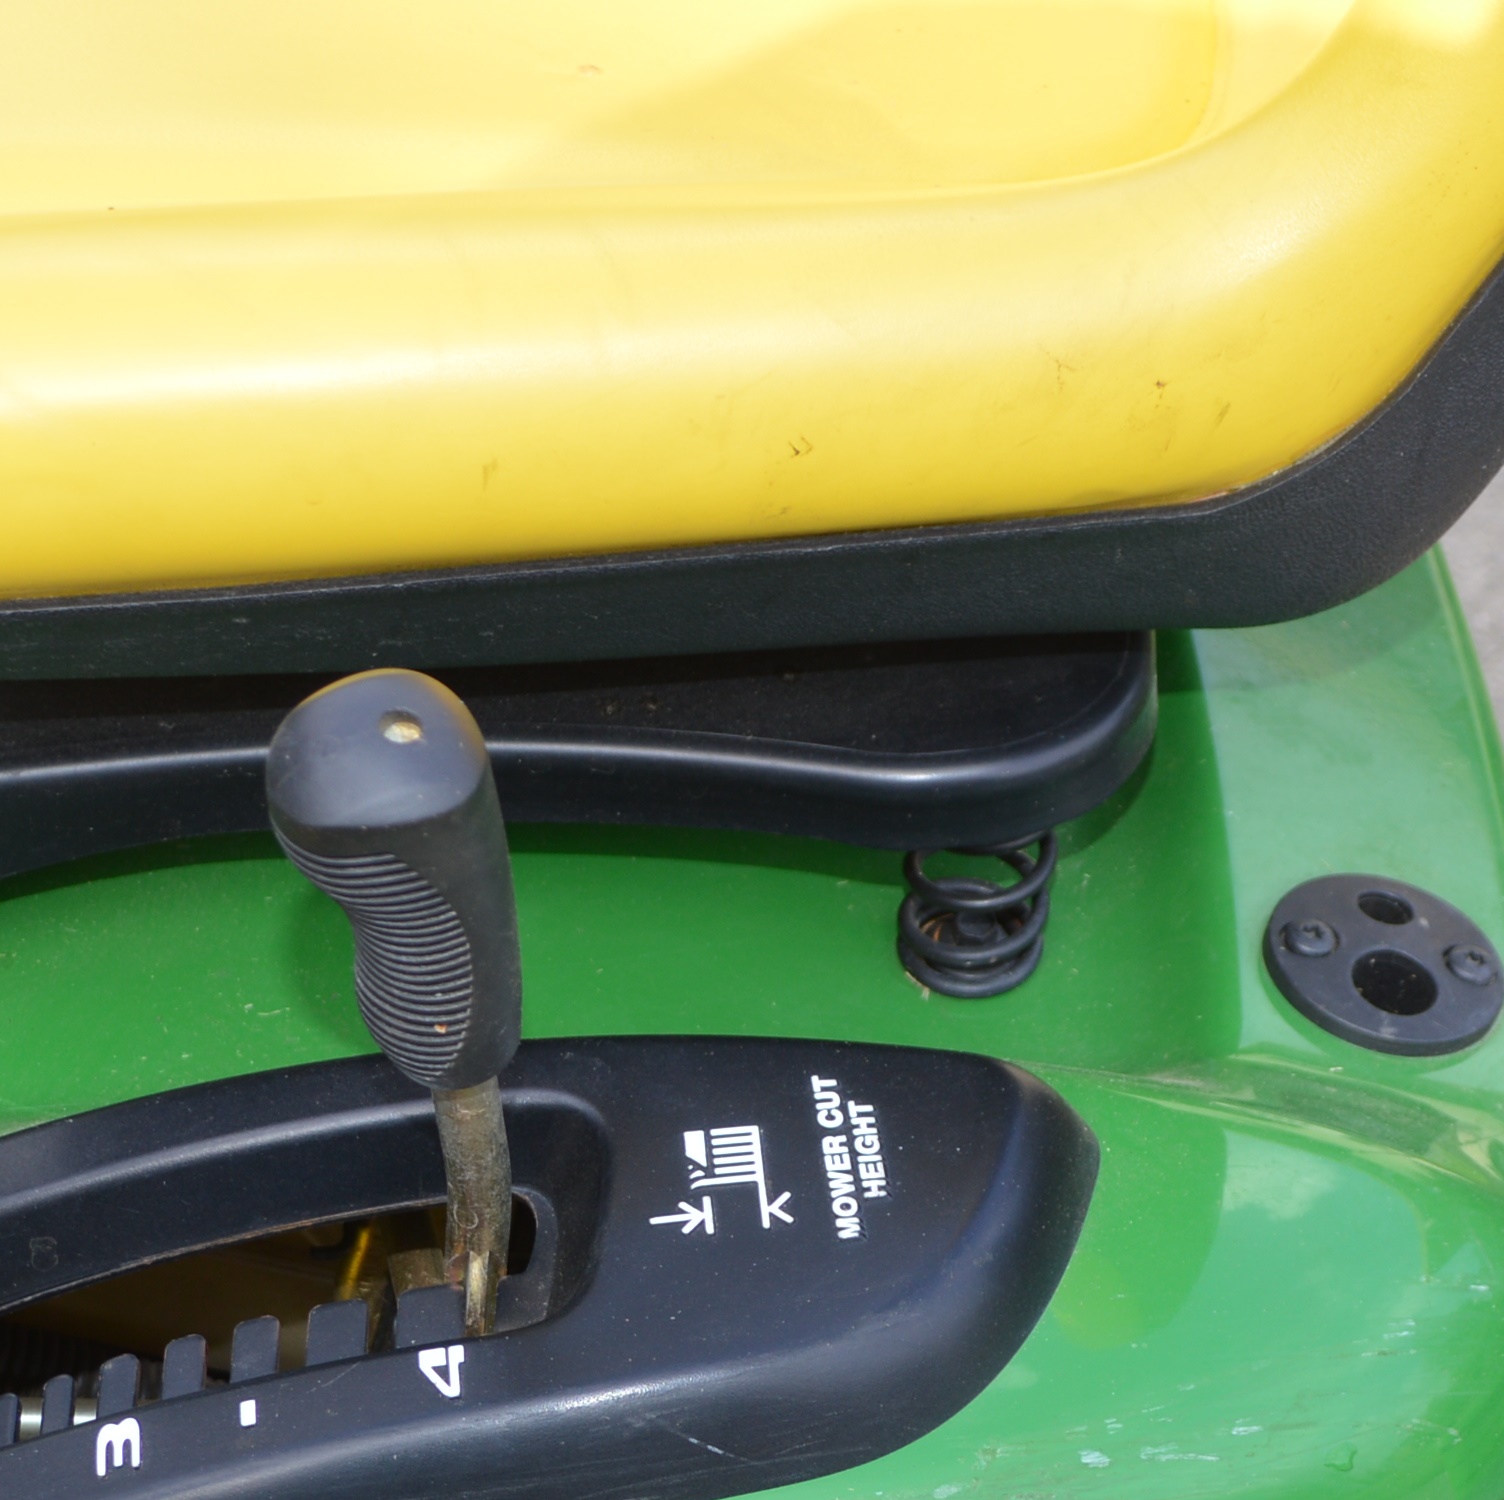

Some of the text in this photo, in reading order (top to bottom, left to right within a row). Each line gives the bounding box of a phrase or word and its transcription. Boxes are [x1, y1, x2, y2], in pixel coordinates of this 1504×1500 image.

[811, 1075, 861, 1239] MOWER CUT
[847, 1100, 887, 1198] HEIGHT
[96, 1417, 141, 1477] 3
[418, 1344, 465, 1398] 4
